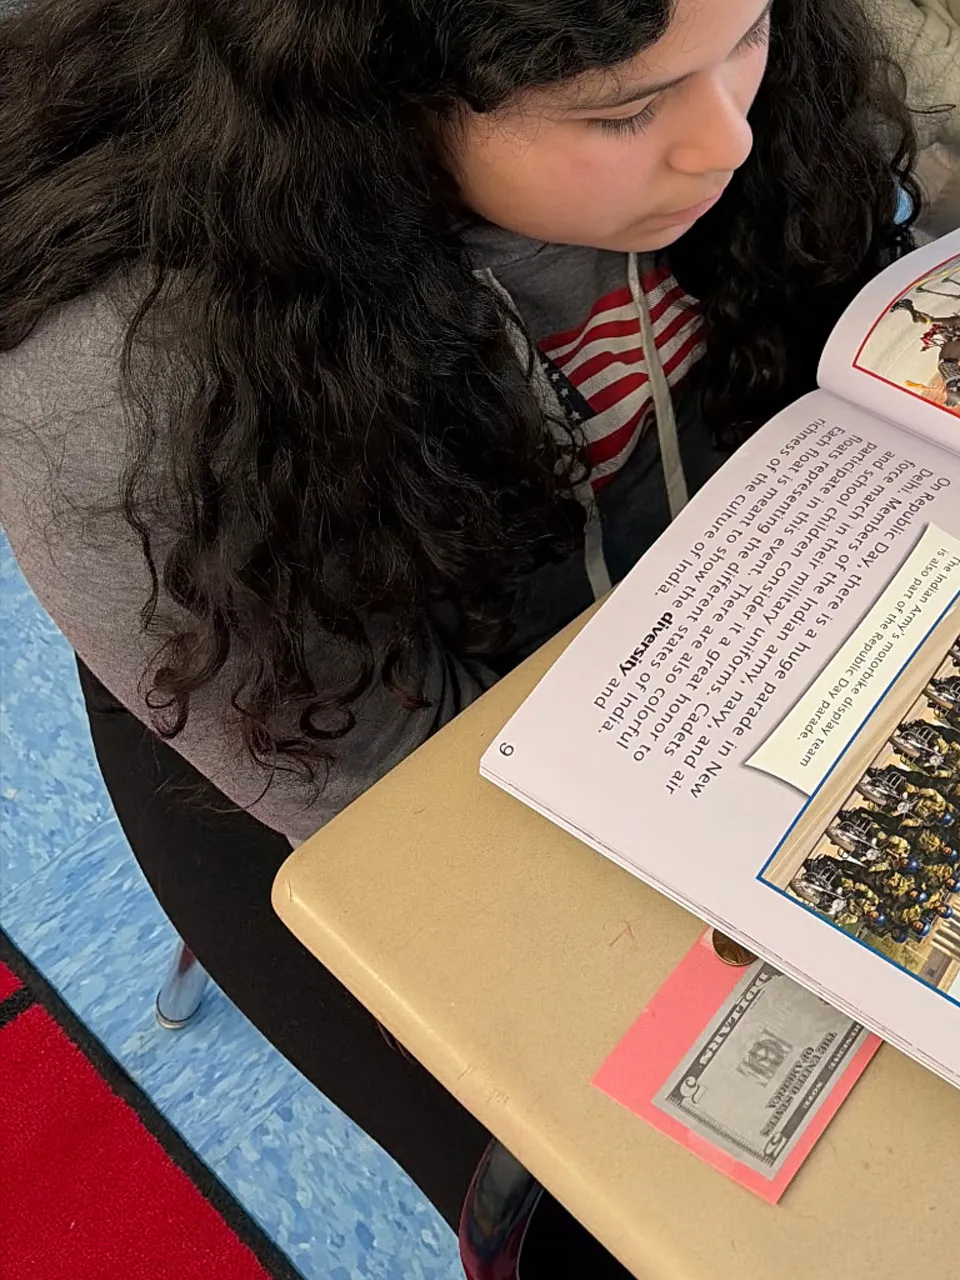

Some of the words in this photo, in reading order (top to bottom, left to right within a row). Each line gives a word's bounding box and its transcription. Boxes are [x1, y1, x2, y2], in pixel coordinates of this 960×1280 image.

[779, 418, 827, 457] richness
[815, 426, 846, 447] Each
[828, 434, 863, 460] floats
[766, 458, 781, 474] of
[788, 448, 820, 474] float
[819, 441, 878, 495] participate
[872, 451, 896, 471] and
[882, 459, 916, 483] force
[744, 473, 768, 492] the
[777, 474, 794, 486] is
[836, 469, 874, 507] school
[897, 468, 934, 494] Delhi.
[930, 477, 951, 491] On
[739, 487, 778, 527] meant
[757, 461, 830, 534] representing
[806, 496, 825, 509] in
[848, 484, 885, 520] march
[704, 494, 746, 539] culture
[783, 511, 810, 536] this
[790, 507, 837, 558] children
[835, 522, 854, 535] in
[848, 497, 902, 552] Members
[883, 492, 935, 541] Republic
[690, 542, 705, 560] of
[726, 529, 743, 543] to
[737, 537, 762, 559] the
[937, 548, 949, 557] is
[694, 546, 727, 583] show
[747, 538, 785, 576] event.
[808, 538, 839, 571] their
[834, 554, 850, 572] of
[856, 541, 890, 568] Day,
[920, 557, 939, 577] also
[654, 559, 694, 596] India.
[686, 562, 739, 623] different
[742, 560, 792, 621] consider
[813, 572, 838, 595] the
[827, 574, 862, 610] there
[903, 577, 922, 599] part
[919, 573, 948, 603] Indian
[672, 585, 697, 608] the
[712, 583, 753, 622] There
[762, 571, 810, 626] military
[894, 600, 906, 614] of
[728, 622, 746, 635] it
[776, 597, 819, 641] Indian
[804, 628, 817, 639] a
[815, 613, 833, 626] is
[879, 613, 897, 630] the
[892, 604, 922, 640] Army's
[619, 612, 673, 677] diversity
[650, 624, 689, 669] states
[691, 625, 714, 649] are
[718, 636, 731, 647] a
[665, 652, 693, 684] also
[685, 648, 721, 691] great
[706, 627, 766, 696] uniforms.
[739, 644, 778, 684] army,
[774, 641, 812, 680] huge
[845, 632, 884, 677] Republic
[850, 641, 894, 695] motorbike
[593, 677, 621, 710] and
[635, 672, 651, 693] of
[828, 677, 850, 700] Day
[598, 692, 639, 733] India.
[616, 687, 666, 750] colorful
[650, 693, 692, 742] honor
[707, 690, 744, 729] navy,
[732, 681, 777, 736] parade
[797, 699, 831, 740] parade.
[821, 696, 853, 737] display
[664, 703, 710, 757] Cadets
[499, 742, 514, 756] 9
[633, 744, 652, 762] to
[683, 735, 711, 769] and
[717, 740, 738, 757] in
[799, 738, 824, 767] team
[665, 770, 685, 795] air
[690, 760, 723, 799] New
[698, 971, 772, 1067] DOLLARS
[816, 1031, 838, 1055] THE
[789, 1052, 822, 1096] UNITED
[760, 1094, 795, 1137] STATES
